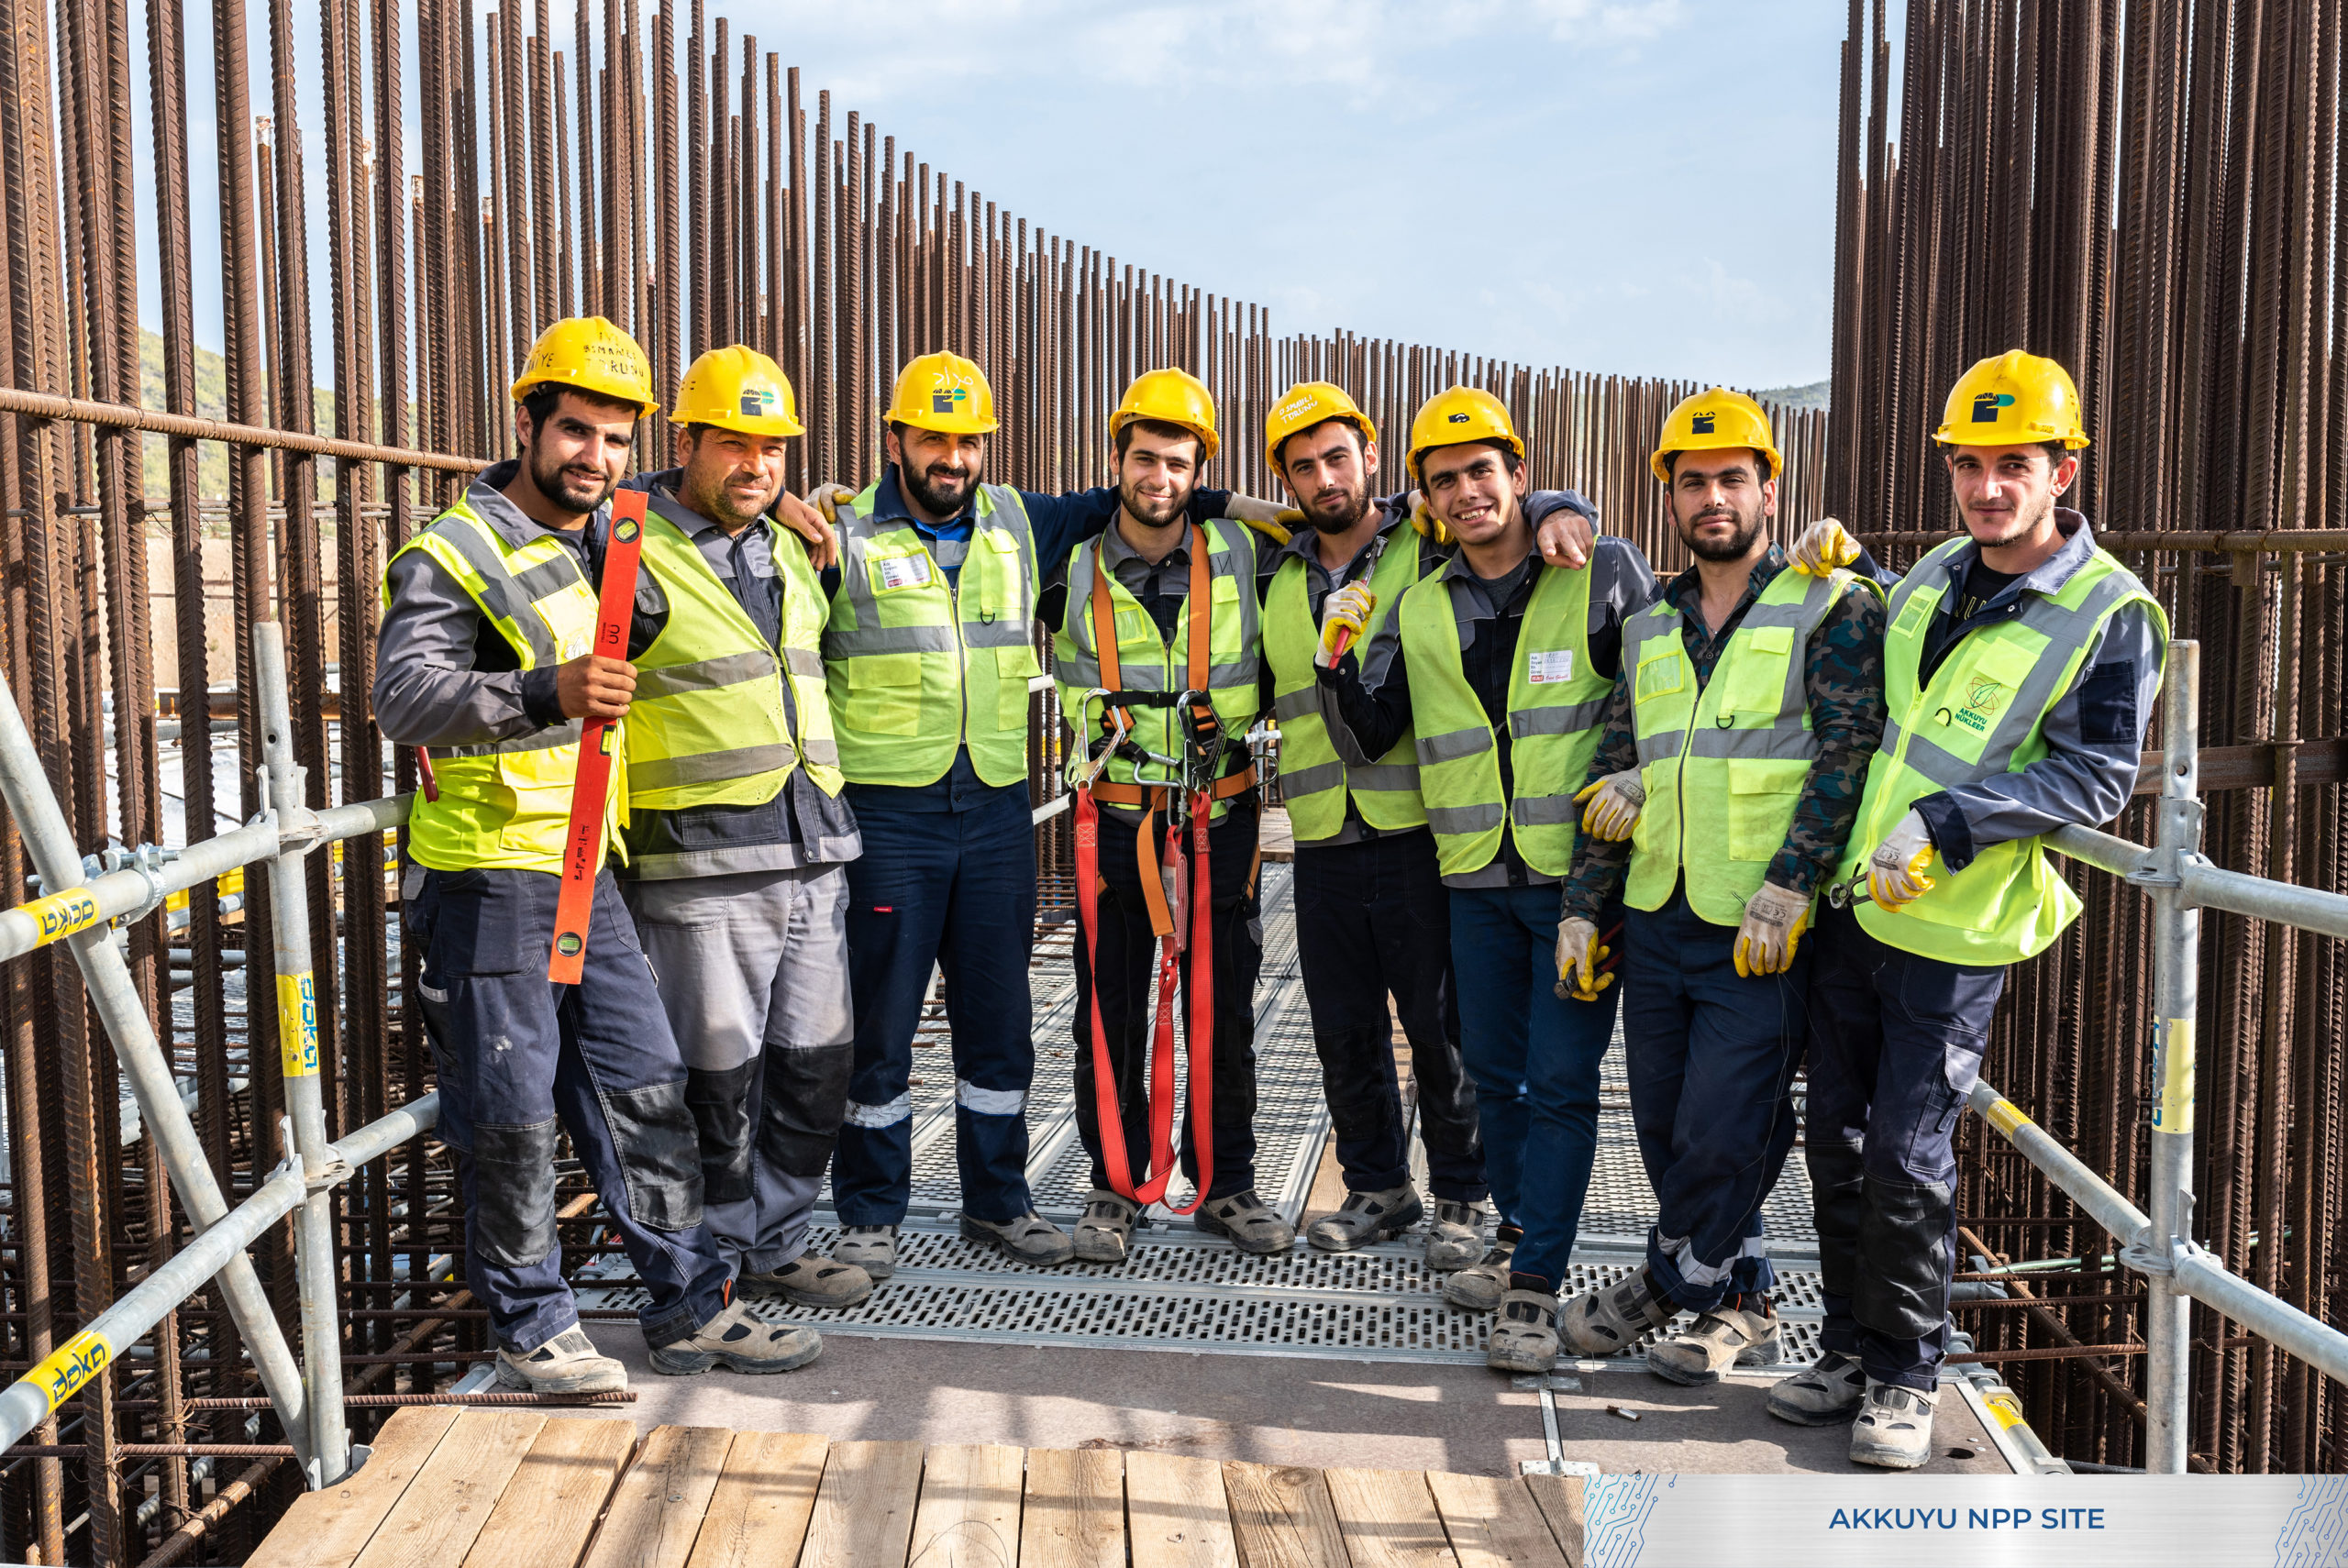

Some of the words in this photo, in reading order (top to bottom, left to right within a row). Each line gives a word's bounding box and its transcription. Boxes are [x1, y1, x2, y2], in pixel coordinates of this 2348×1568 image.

[1955, 713, 1986, 732] NÜKLEER
[1959, 708, 1988, 725] AKKUYU
[41, 900, 94, 936] doka
[52, 1342, 105, 1403] doka
